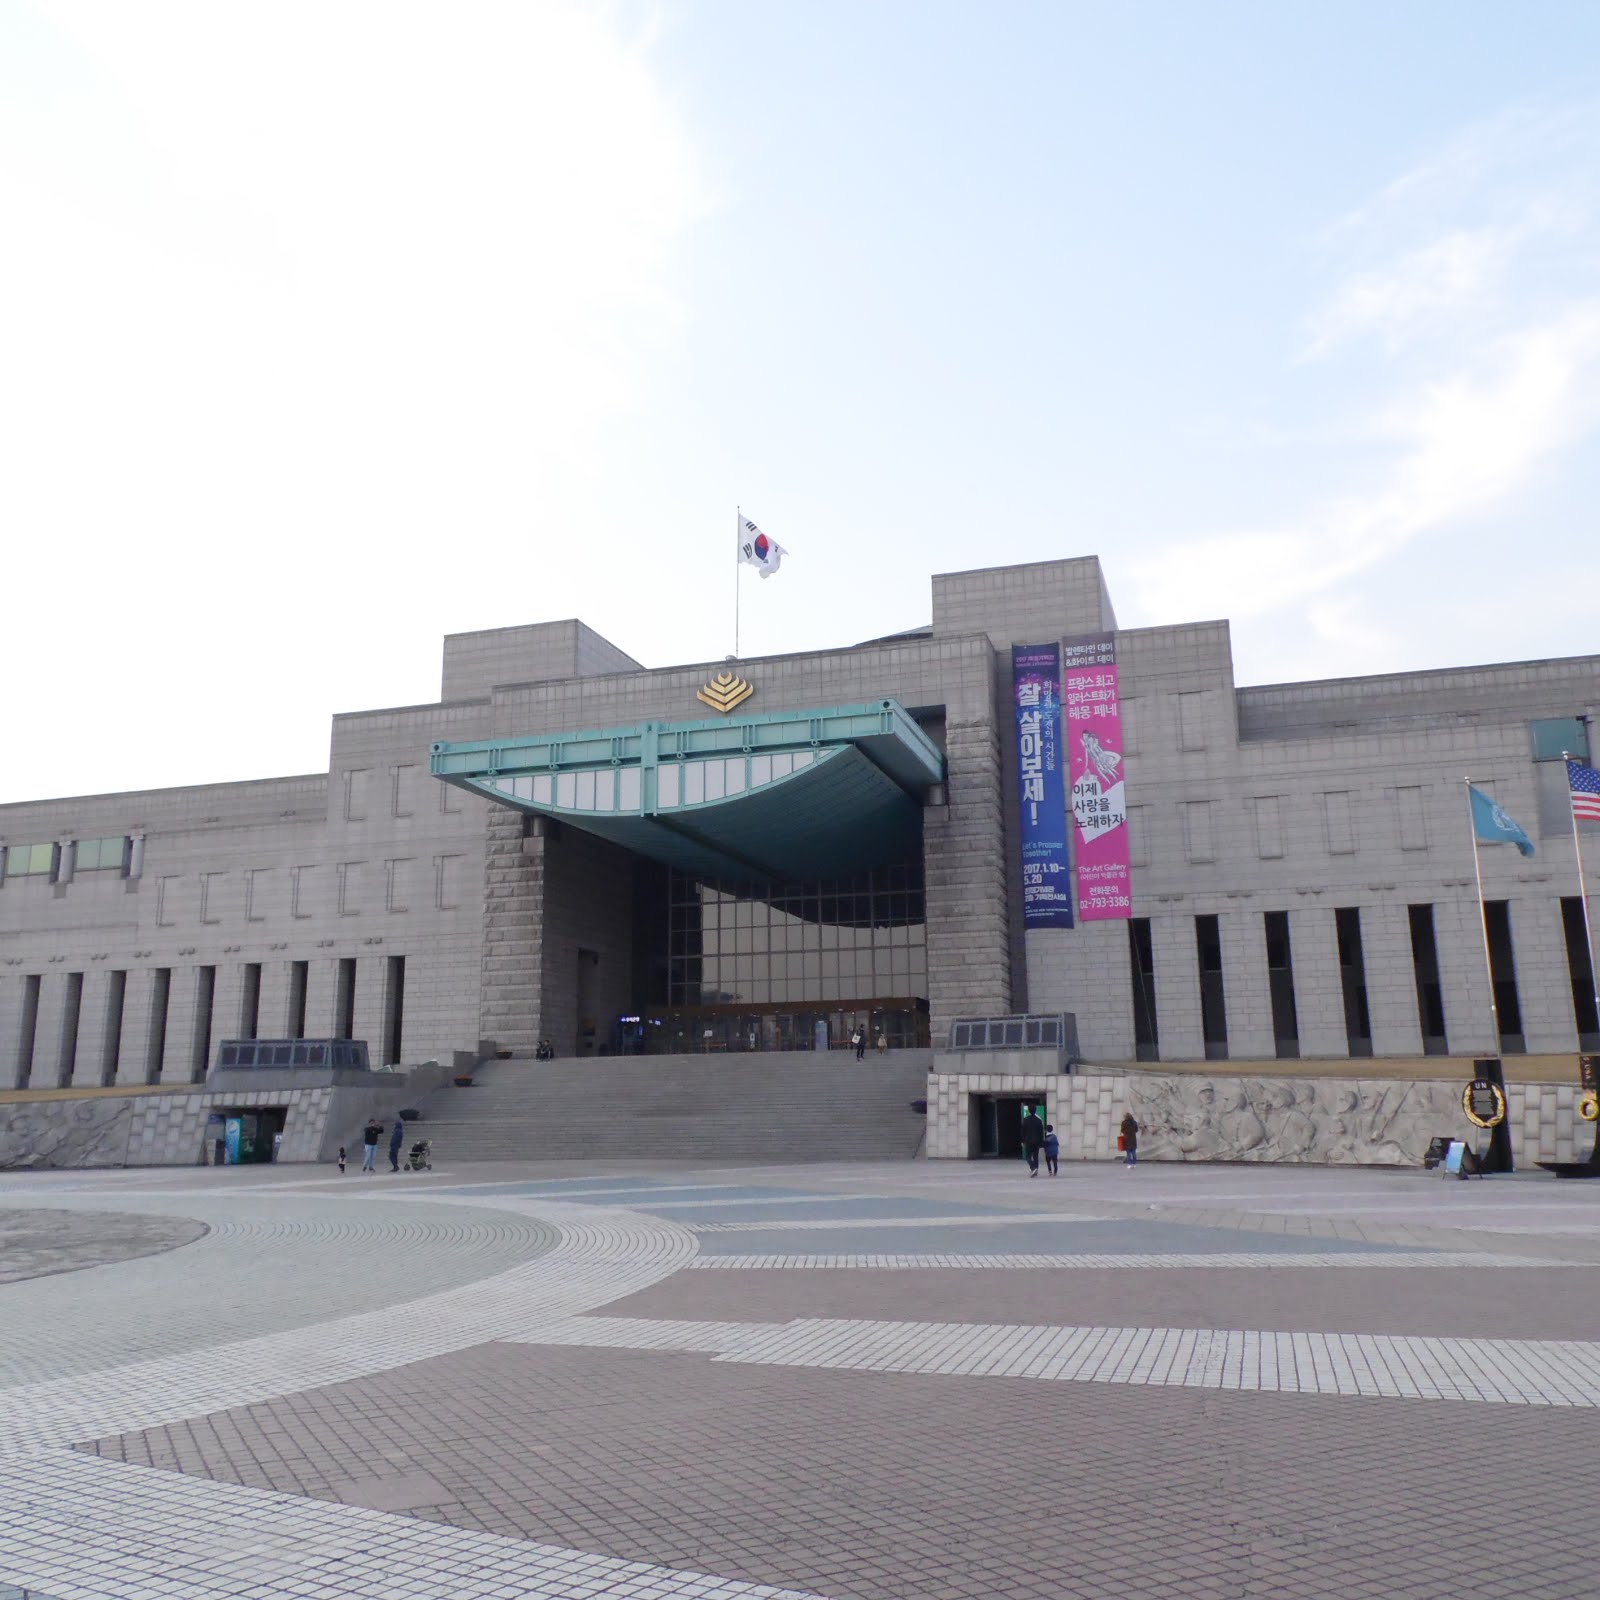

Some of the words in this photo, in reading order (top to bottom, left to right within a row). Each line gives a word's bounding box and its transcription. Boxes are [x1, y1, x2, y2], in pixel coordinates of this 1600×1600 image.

[1065, 644, 1096, 656] 발렌타인
[1097, 642, 1113, 653] 데이
[1065, 656, 1096, 667] &화이트
[1097, 654, 1114, 664] 데이
[1067, 676, 1095, 690] 프랑스
[1096, 674, 1115, 687] 최고
[1018, 683, 1041, 707] 잘
[1067, 689, 1116, 705] 일러스트화가
[1094, 703, 1118, 718] 페네
[1019, 711, 1045, 826] 살아보세!
[1073, 782, 1097, 797] 이제
[1074, 797, 1111, 813] 사랑을
[1075, 813, 1125, 829] 노래하자
[1078, 865, 1091, 873] The
[1023, 874, 1043, 885] 5.20
[1089, 885, 1119, 896] 전화문의
[1080, 896, 1130, 909] 02-793-3386
